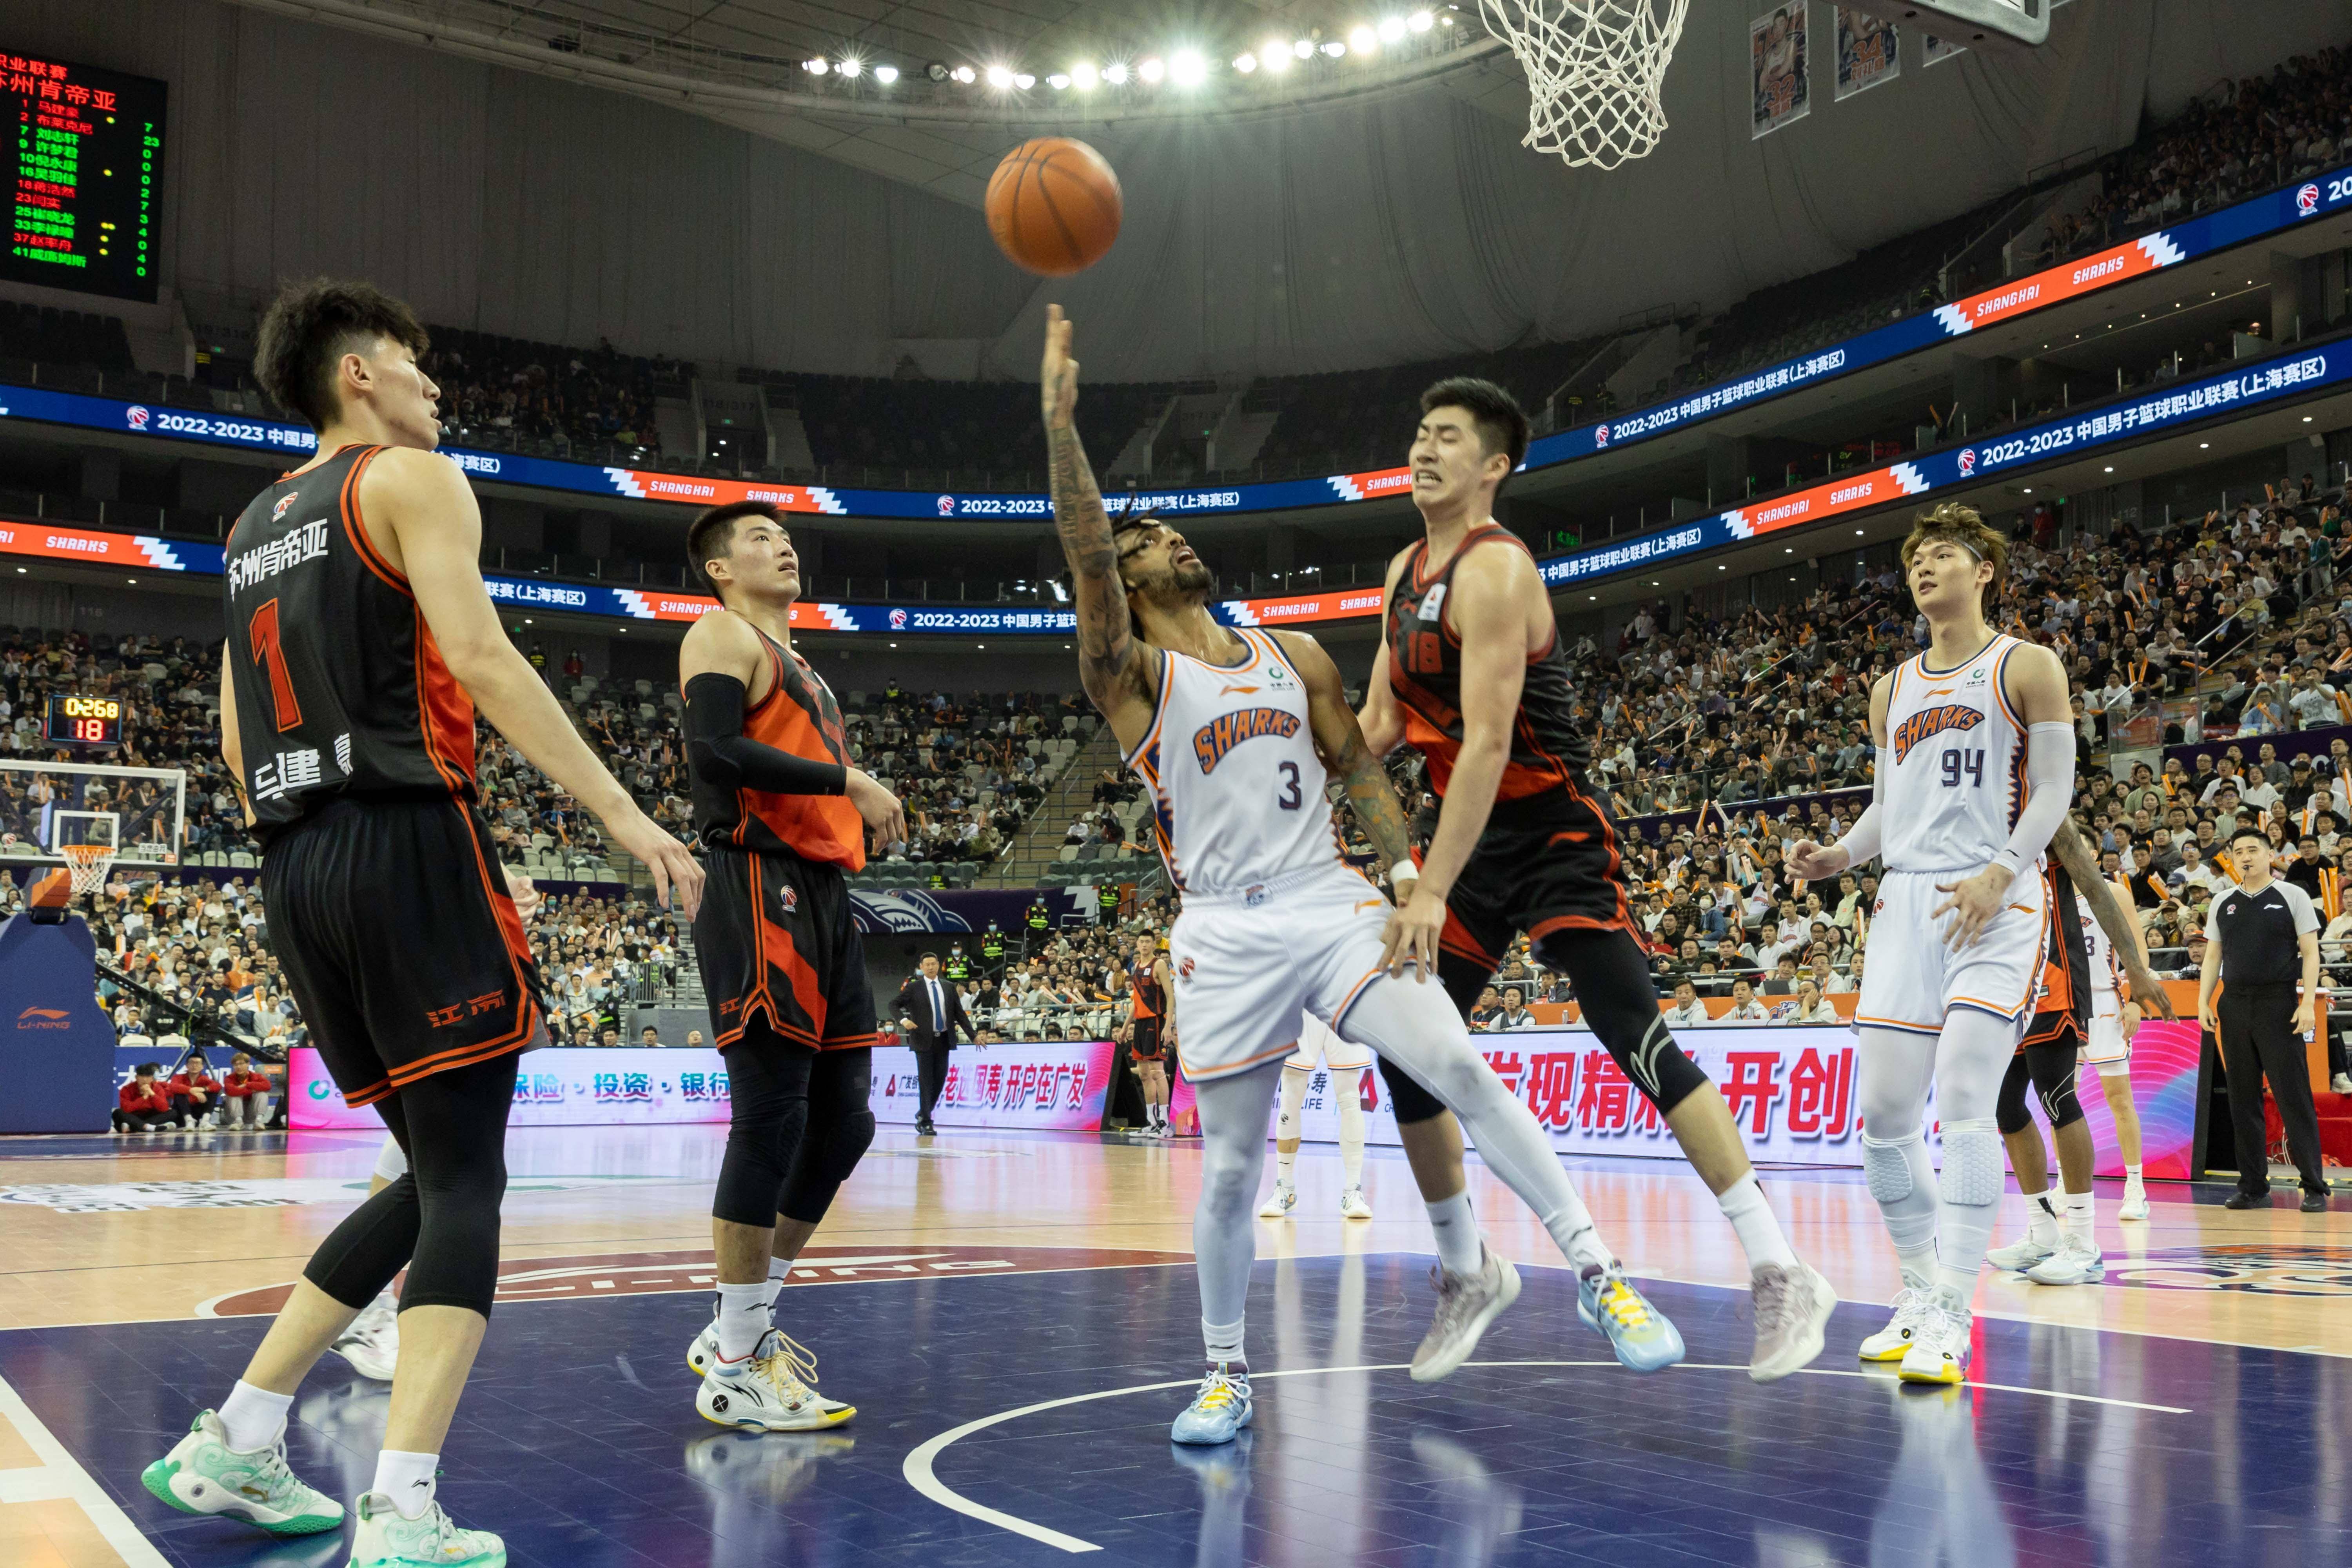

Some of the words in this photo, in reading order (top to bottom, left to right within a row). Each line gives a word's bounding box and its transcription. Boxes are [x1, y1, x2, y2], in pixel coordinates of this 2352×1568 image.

[20, 112, 28, 121] 2
[144, 136, 159, 147] 23
[20, 125, 28, 134] 7
[143, 149, 151, 158] 0
[145, 123, 152, 132] 7
[19, 139, 28, 148] 9
[142, 162, 151, 171] 0
[20, 152, 35, 168] 10
[142, 175, 150, 184] 0
[18, 180, 33, 189] 18
[141, 201, 149, 210] 7
[19, 166, 34, 176] 16
[141, 189, 149, 198] 2
[15, 206, 32, 217] 25
[139, 228, 147, 237] 4
[16, 192, 32, 203] 23
[140, 214, 148, 224] 3
[14, 233, 29, 243] 37
[137, 254, 146, 263] 4
[15, 219, 31, 230] 33
[138, 241, 147, 250] 0
[13, 247, 28, 257] 41
[137, 267, 146, 276] 0
[1977, 284, 2040, 317] SHANGHAI
[2073, 256, 2124, 285] SHARKS
[1614, 407, 1678, 439] 2022-2023
[1681, 349, 1844, 417] 中国男子篮球职业联赛(上海赛区)
[1983, 426, 2073, 466] 2022-2023
[2077, 353, 2326, 440] 中国男子篮球职业联赛(上海赛区)
[158, 414, 263, 441] 2022-2023
[267, 427, 319, 450] 中国男
[431, 450, 501, 474] 海赛区)
[650, 481, 715, 497] SHANGHAI
[746, 490, 794, 503] SHARKS
[962, 500, 1045, 513] 2022-2023
[1757, 499, 1809, 524] SHANGHAI
[1830, 483, 1872, 505] SHARKS
[46, 536, 108, 553] SHARKS
[228, 517, 328, 603] 苏州肯帝亚
[1548, 528, 1701, 580] 中国男子篮球职业联赛(上海赛区)
[914, 613, 999, 627] 2022-2023
[1263, 603, 1319, 617] SHANGHAI
[1340, 596, 1381, 610] SHARKS
[250, 597, 303, 733] 1
[76, 719, 103, 741] 18
[1192, 707, 1301, 776] SHARKS
[1893, 704, 1985, 766] SHARKS
[1940, 748, 1985, 788] 94
[1277, 759, 1302, 811] 3
[17, 1021, 71, 1030] LI-NING
[1003, 1063, 1087, 1105] 开户在广发
[1483, 1051, 1693, 1131] 发现精
